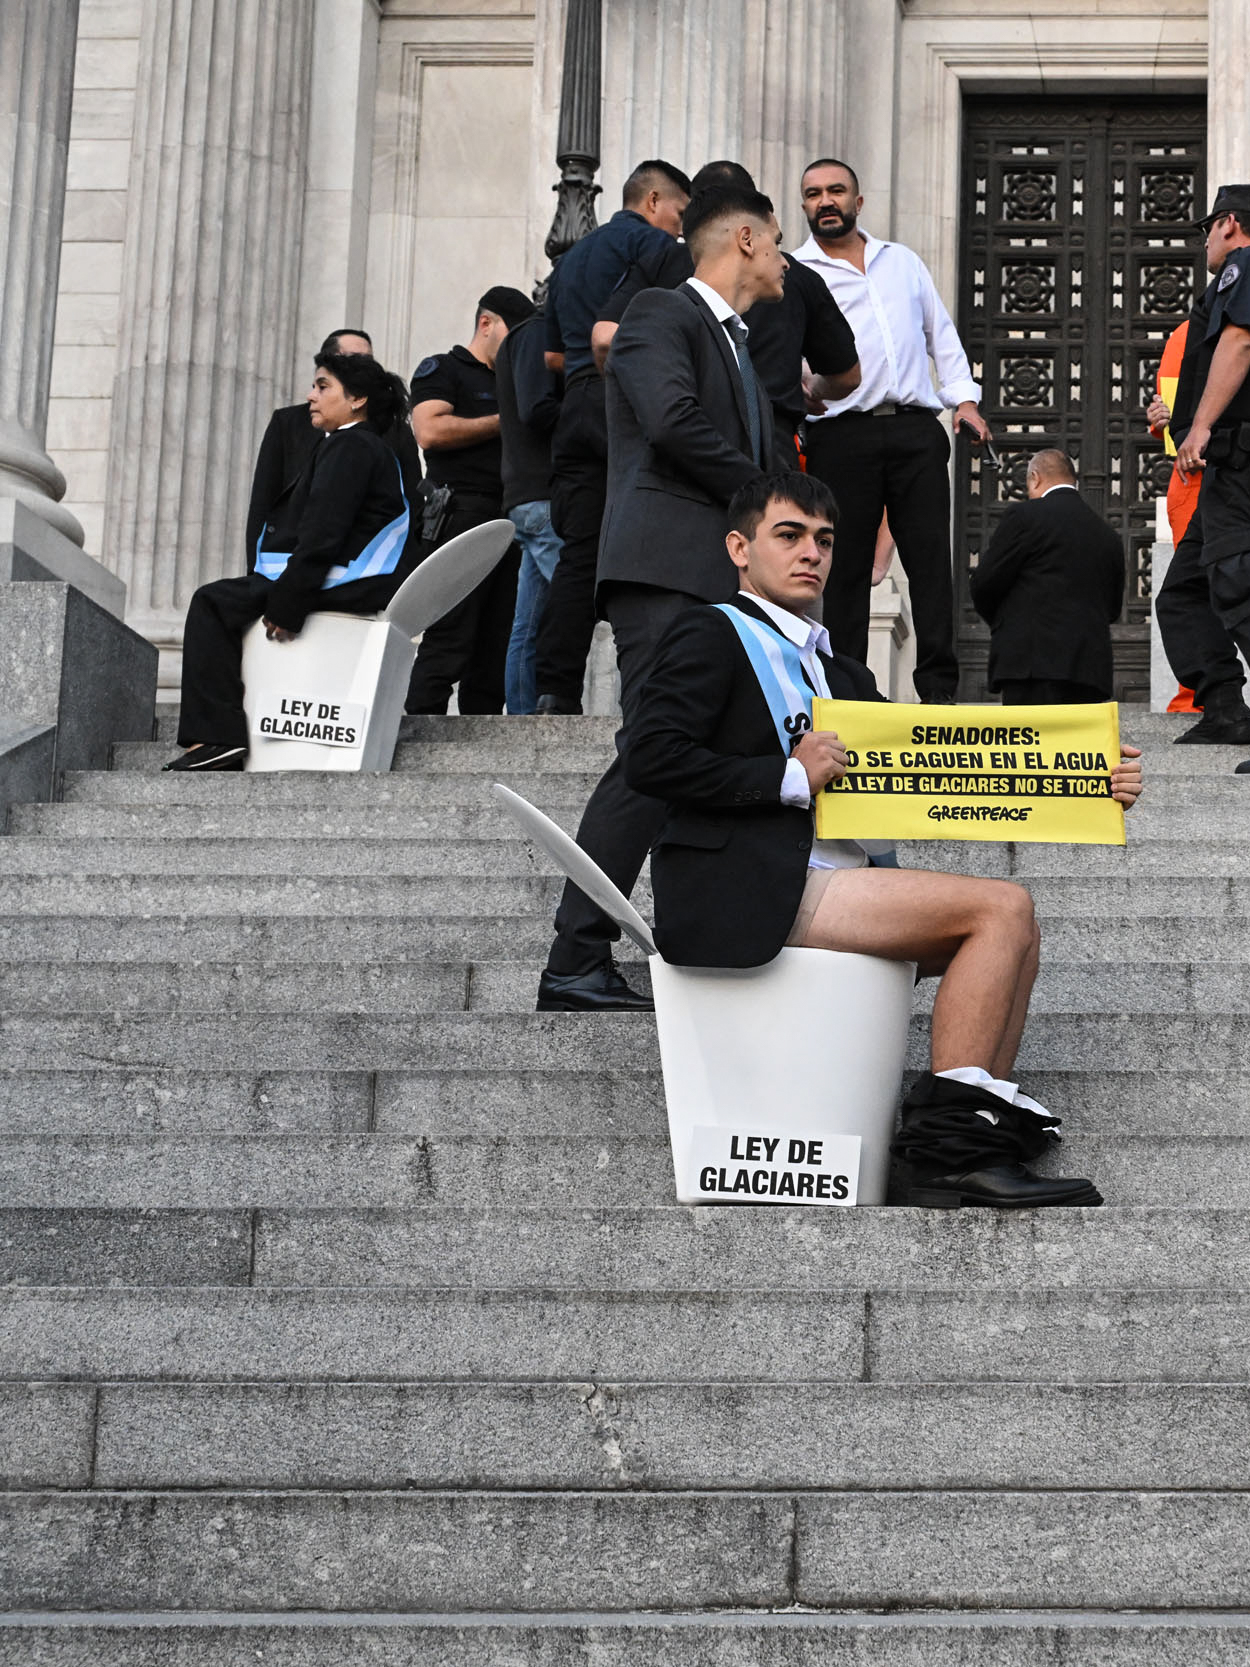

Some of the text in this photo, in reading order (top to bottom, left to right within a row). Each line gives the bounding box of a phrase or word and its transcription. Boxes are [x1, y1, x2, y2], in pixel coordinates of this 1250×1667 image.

[281, 699, 341, 721] LEY DE
[260, 717, 356, 743] GLACIARES
[911, 725, 1040, 745] SENADORES:
[846, 750, 1108, 771] O SE CAGUEN EN EL AGUA
[832, 776, 1109, 795] LA LEY DE GLACIARES NO SE TOCA
[927, 805, 1033, 822] GREENPEACE
[730, 1135, 823, 1165] LEY DE
[700, 1166, 849, 1200] GLACIARES
